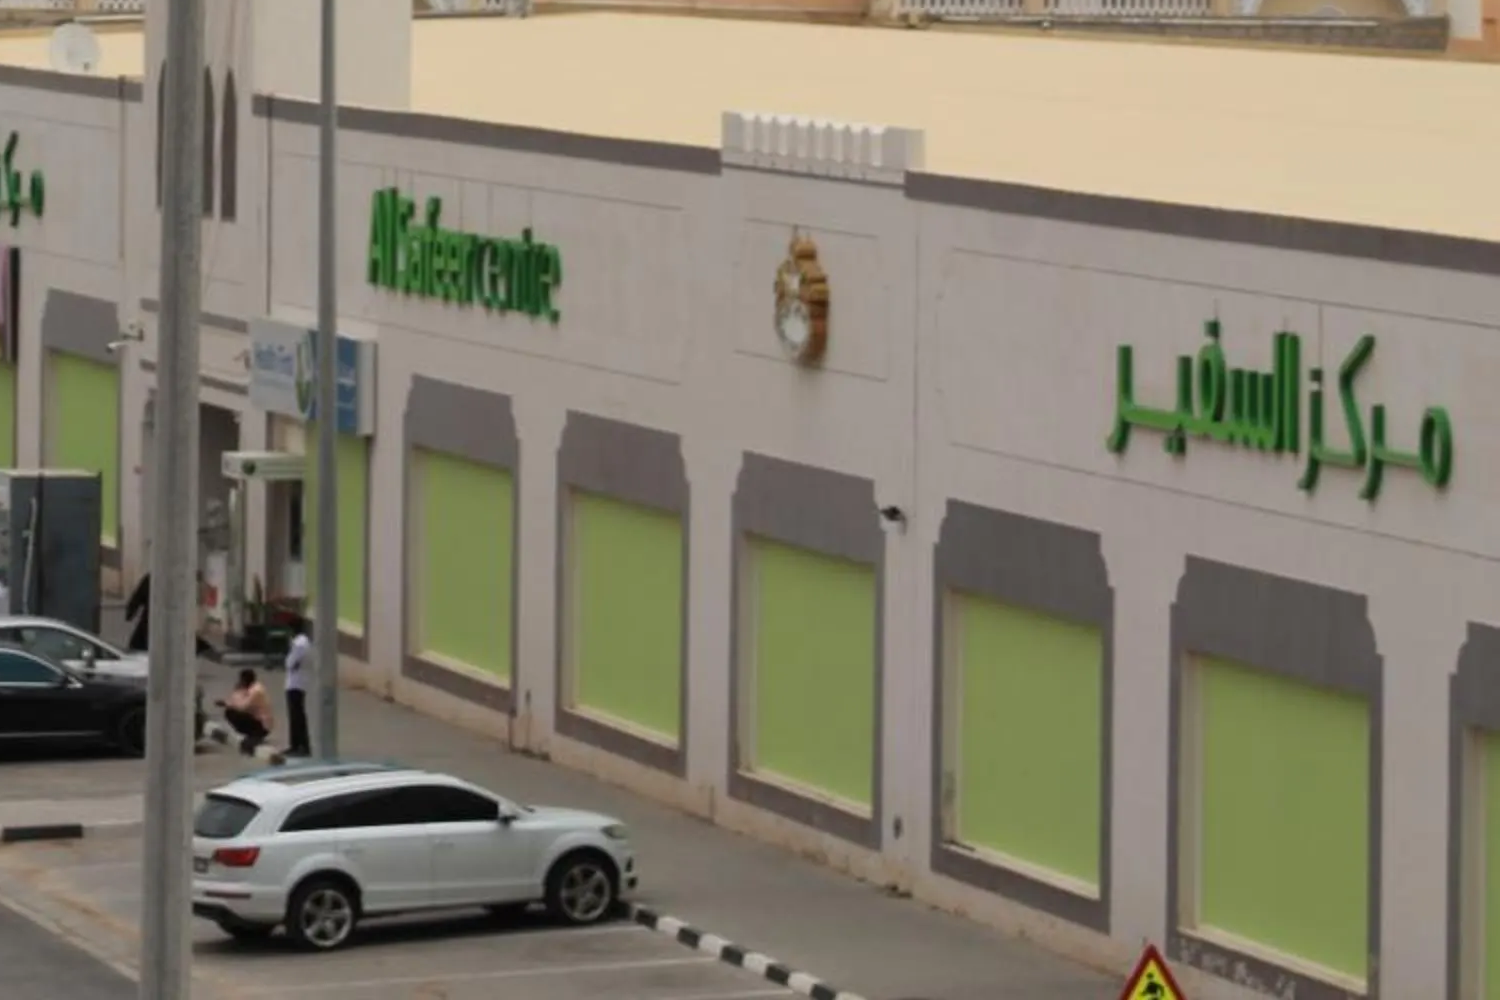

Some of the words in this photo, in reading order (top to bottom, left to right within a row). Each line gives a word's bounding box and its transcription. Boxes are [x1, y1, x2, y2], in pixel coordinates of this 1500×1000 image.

[368, 186, 399, 291] Al
[1106, 319, 1300, 456] السفير
[1297, 334, 1453, 501] مركز
